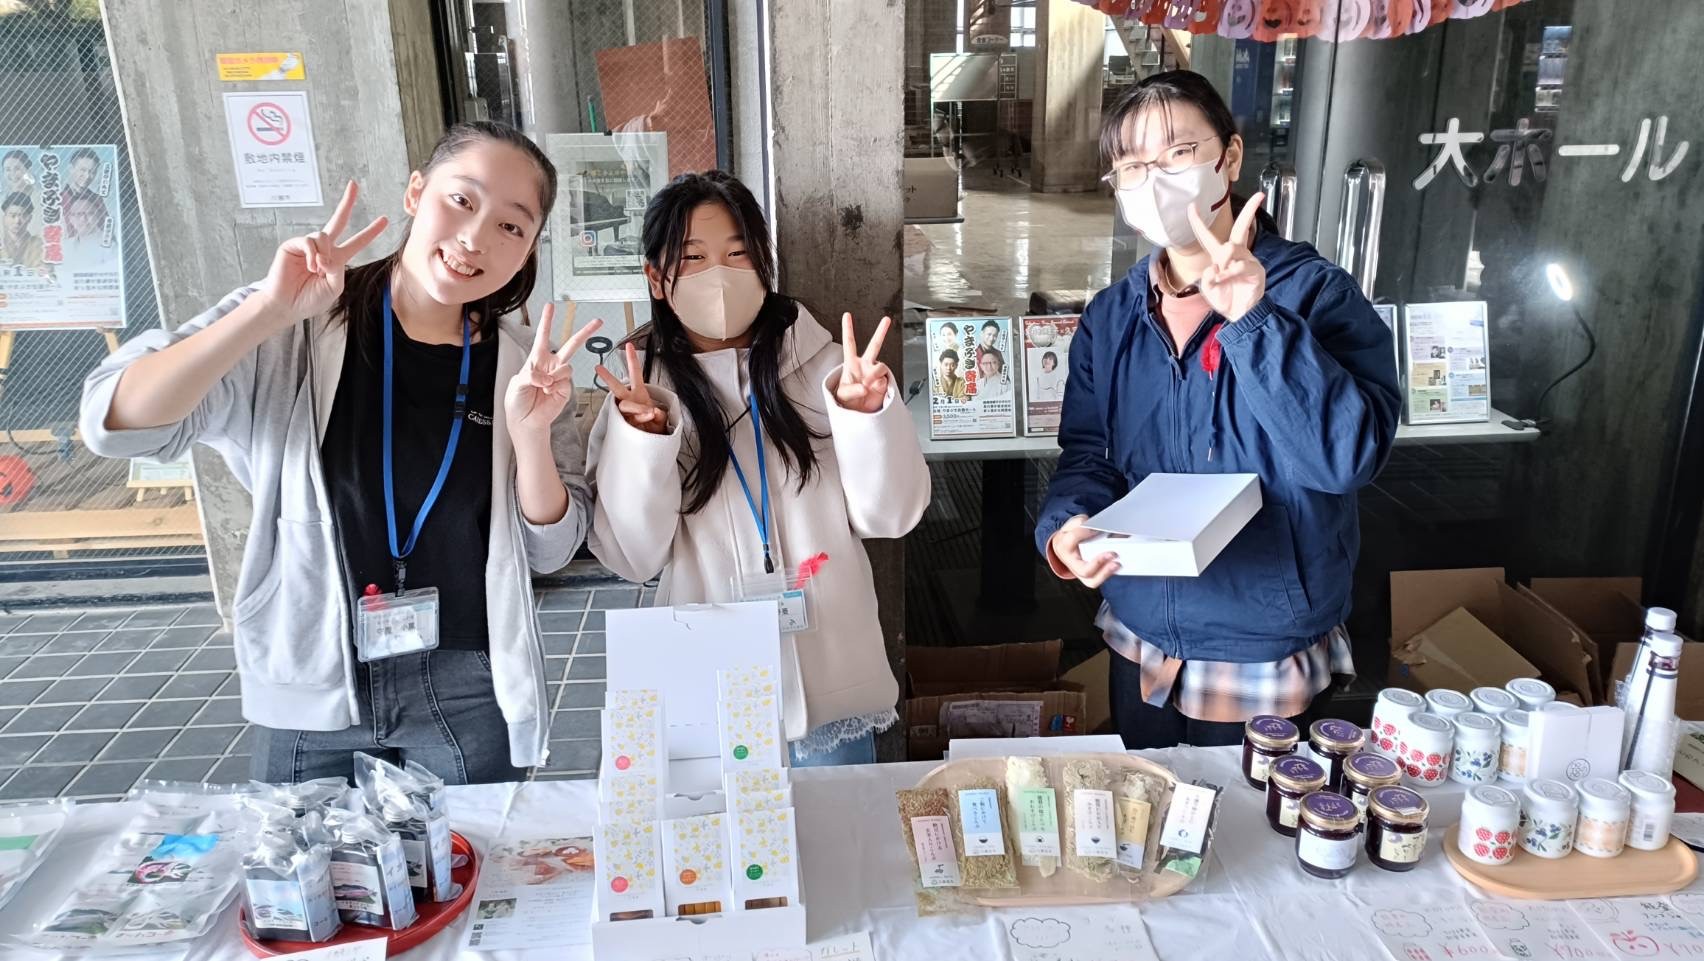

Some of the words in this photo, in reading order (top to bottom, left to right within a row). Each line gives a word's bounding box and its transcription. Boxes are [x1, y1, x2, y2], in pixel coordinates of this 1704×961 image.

[244, 152, 304, 164] 敷地内禁煙
[1413, 115, 1690, 191] 大ホール
[963, 324, 977, 394] やまぶき寄席
